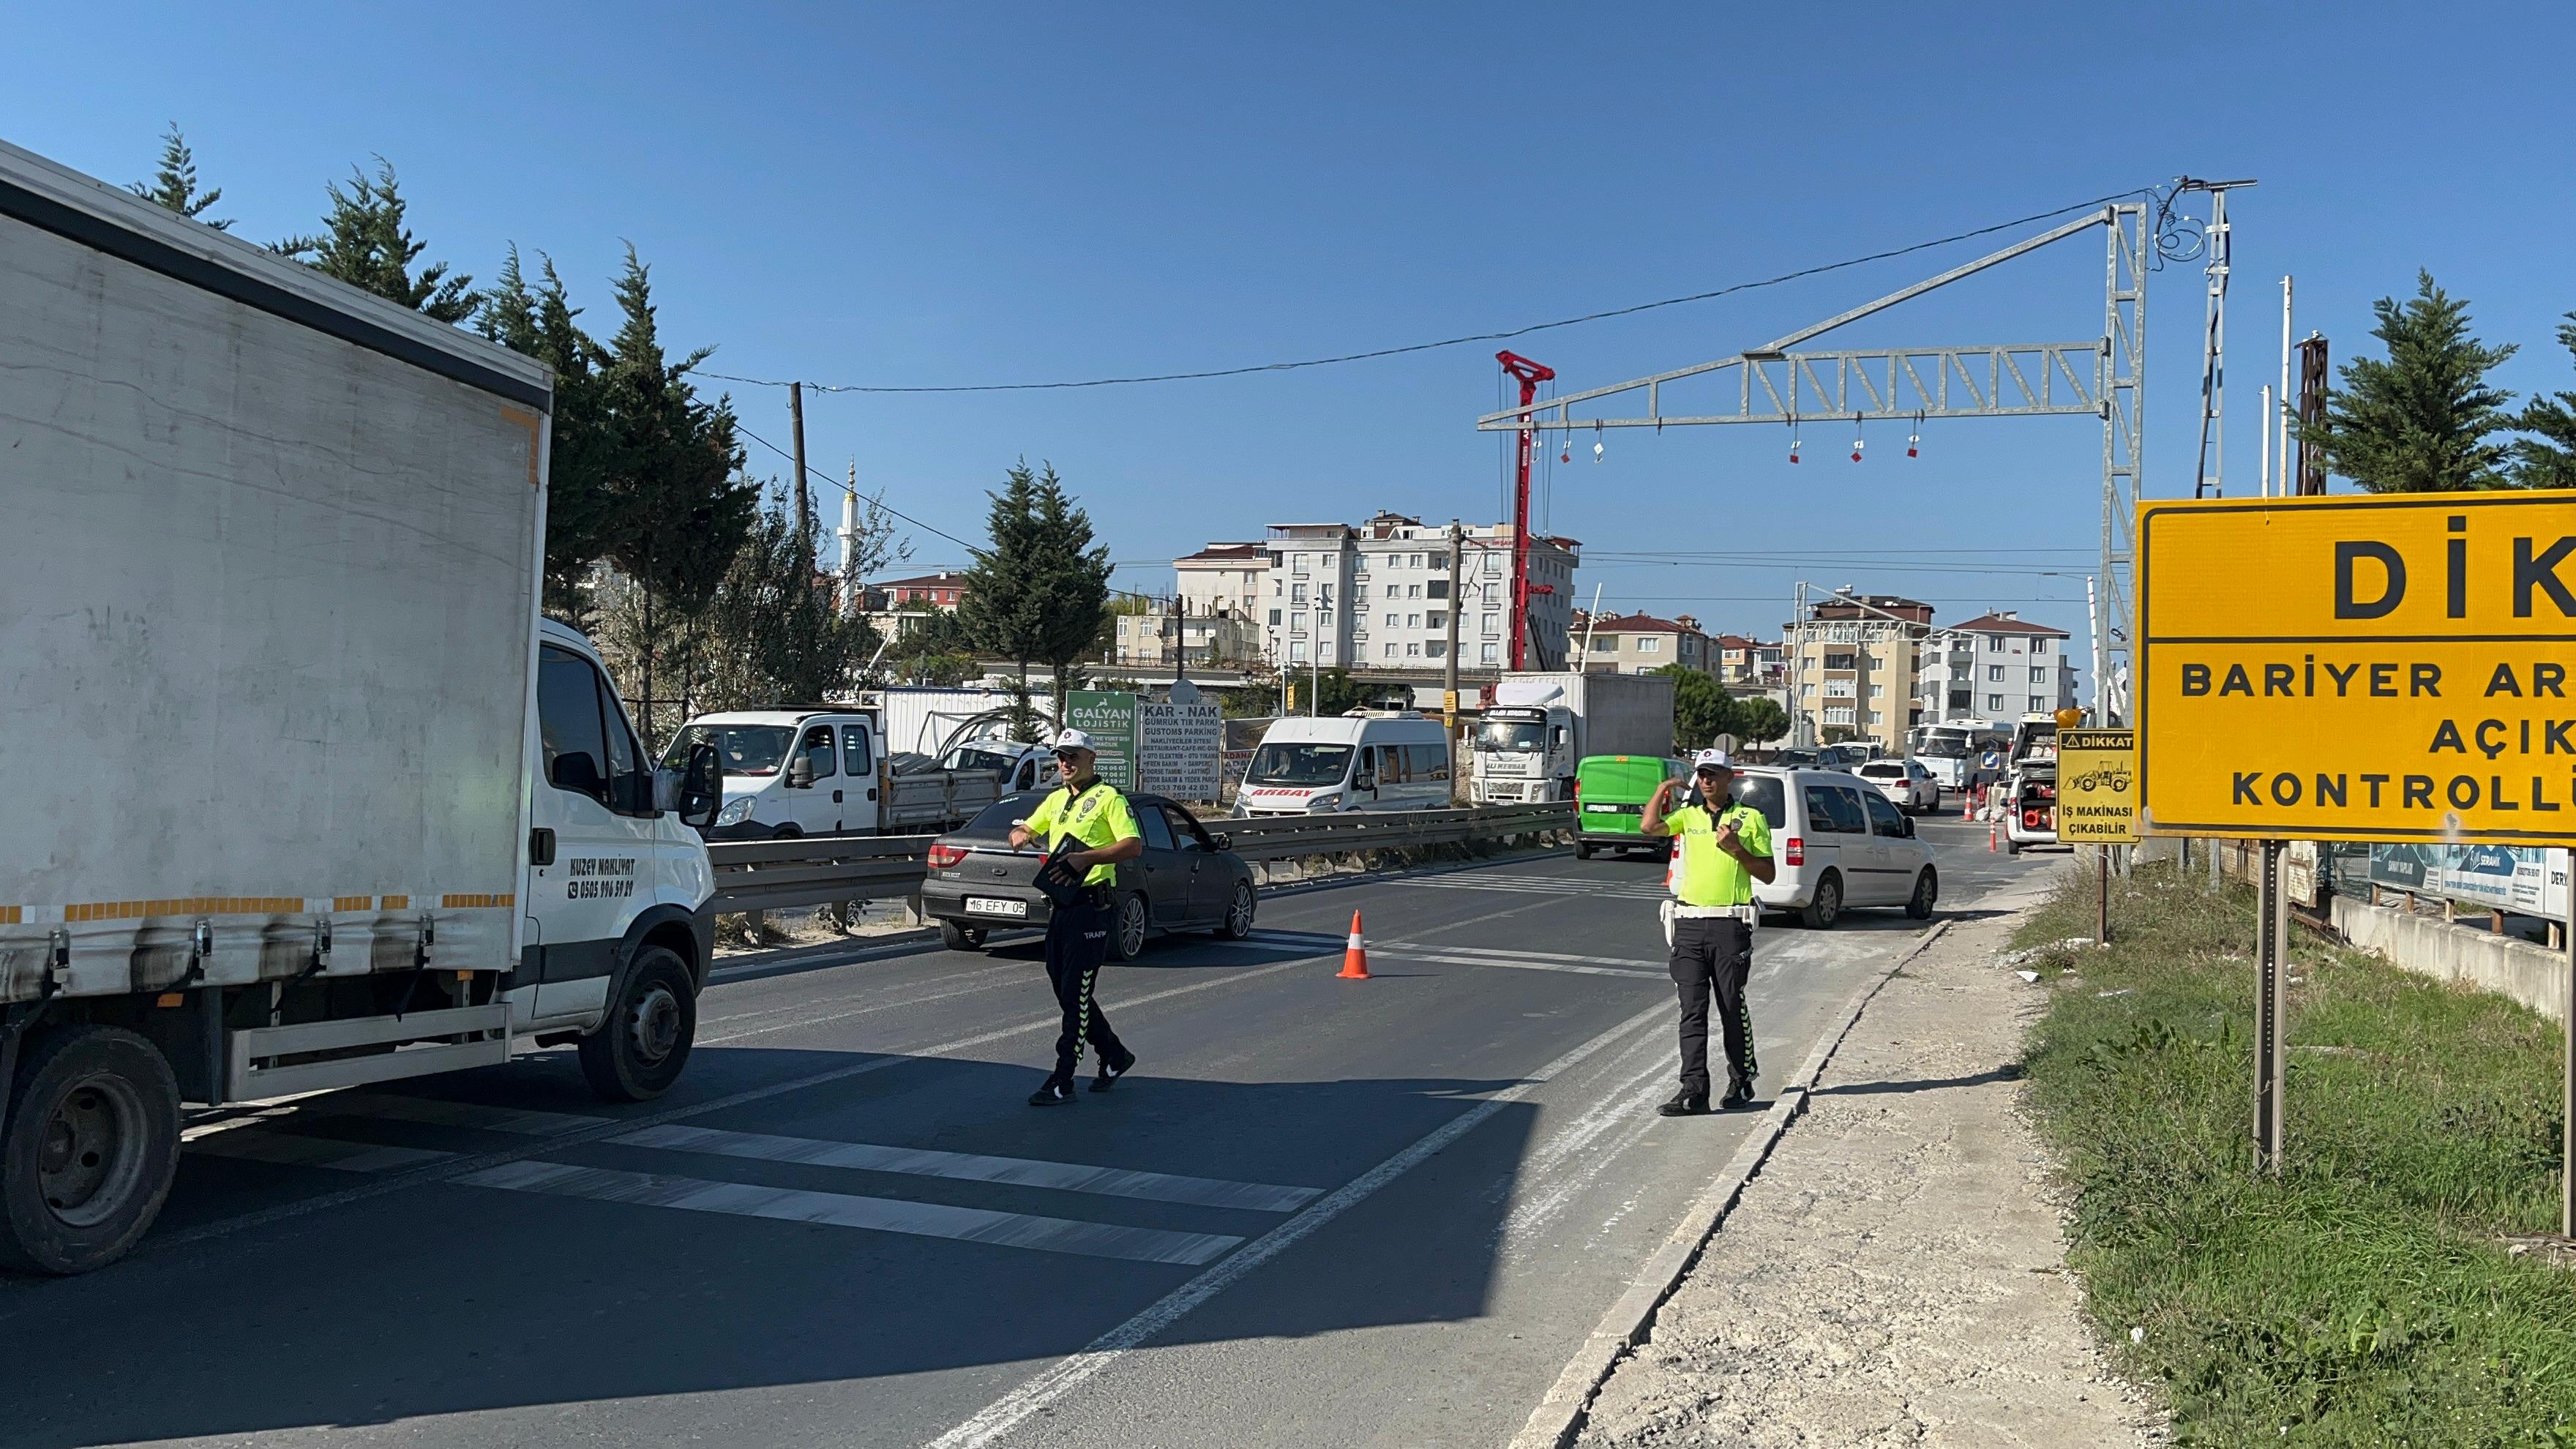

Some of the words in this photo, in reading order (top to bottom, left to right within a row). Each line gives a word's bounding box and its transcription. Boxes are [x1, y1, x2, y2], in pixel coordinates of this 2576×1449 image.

[2334, 515, 2576, 619] DİK
[2182, 654, 2443, 697] BARİYER
[2484, 663, 2566, 698] AR
[1073, 708, 1131, 719] GALYAN
[1145, 706, 1175, 717] KAR
[1188, 706, 1218, 717] NAK
[1076, 719, 1128, 727] LOJİSTİK
[1145, 718, 1179, 726] GÜMRÜK
[2082, 735, 2133, 747] DİKKAT
[2428, 719, 2576, 760] AÇIK
[2233, 765, 2576, 811] KONTROLL
[2062, 804, 2073, 819] İŞ
[2077, 804, 2133, 817] MAKİNASI
[2069, 822, 2126, 836] ÇIKABİLİR
[570, 858, 596, 876] KUZEY
[598, 853, 635, 876] NAKLİYAT
[580, 880, 599, 899] 0505
[600, 880, 613, 898] 996
[615, 880, 624, 897] 59
[986, 900, 1007, 912] EFY
[1012, 902, 1025, 913] 05
